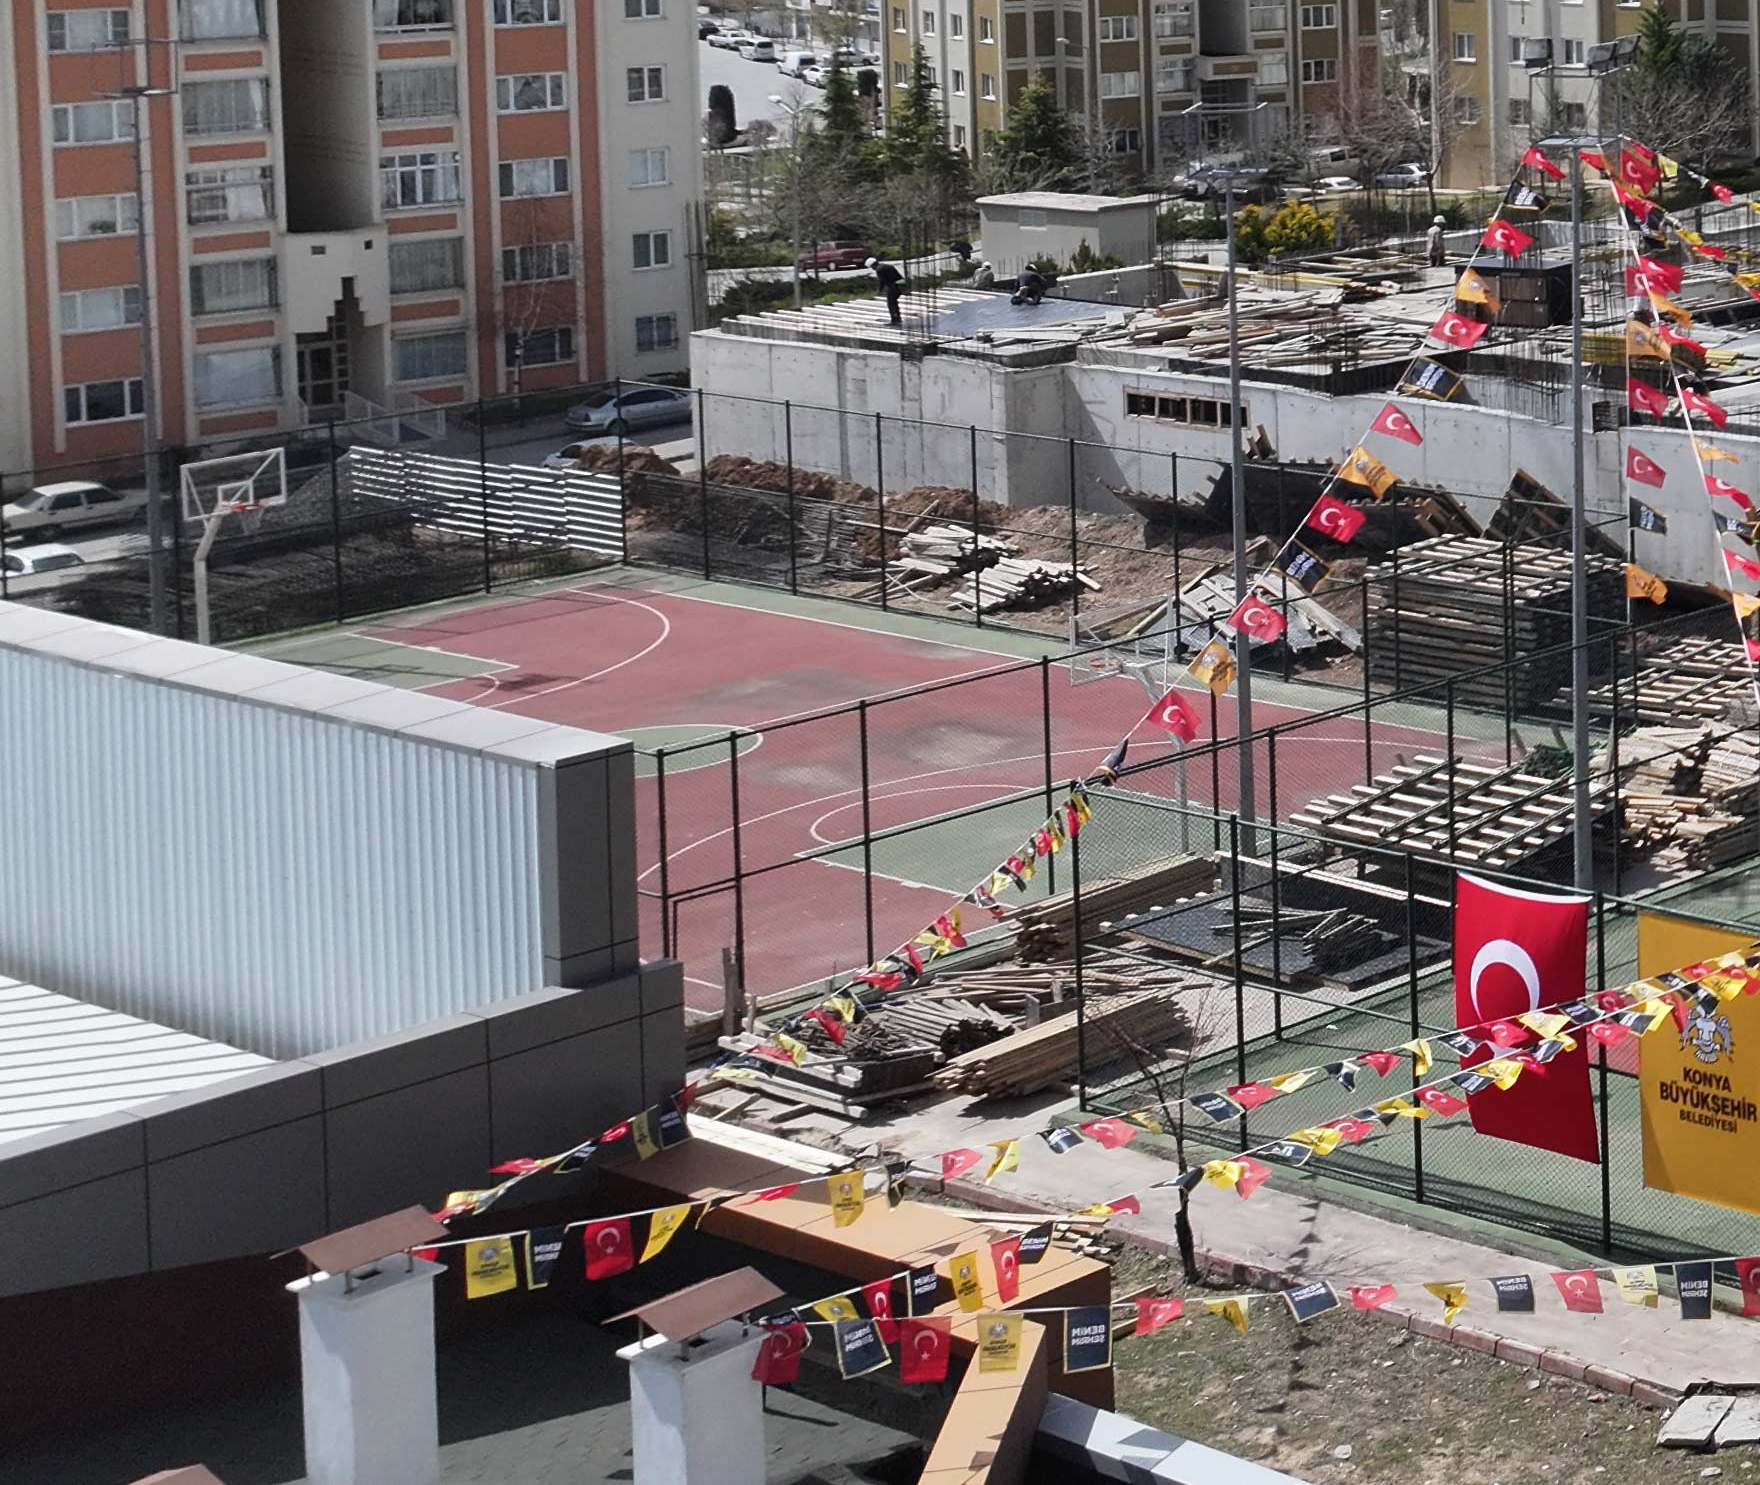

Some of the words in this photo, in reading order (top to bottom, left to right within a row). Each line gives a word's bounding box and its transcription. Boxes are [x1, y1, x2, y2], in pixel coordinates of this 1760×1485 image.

[1683, 1066, 1732, 1093] KONYA
[1660, 1080, 1757, 1123] BÜYÜKŞEHİR
[1679, 1109, 1738, 1134] BELEDİYESİ
